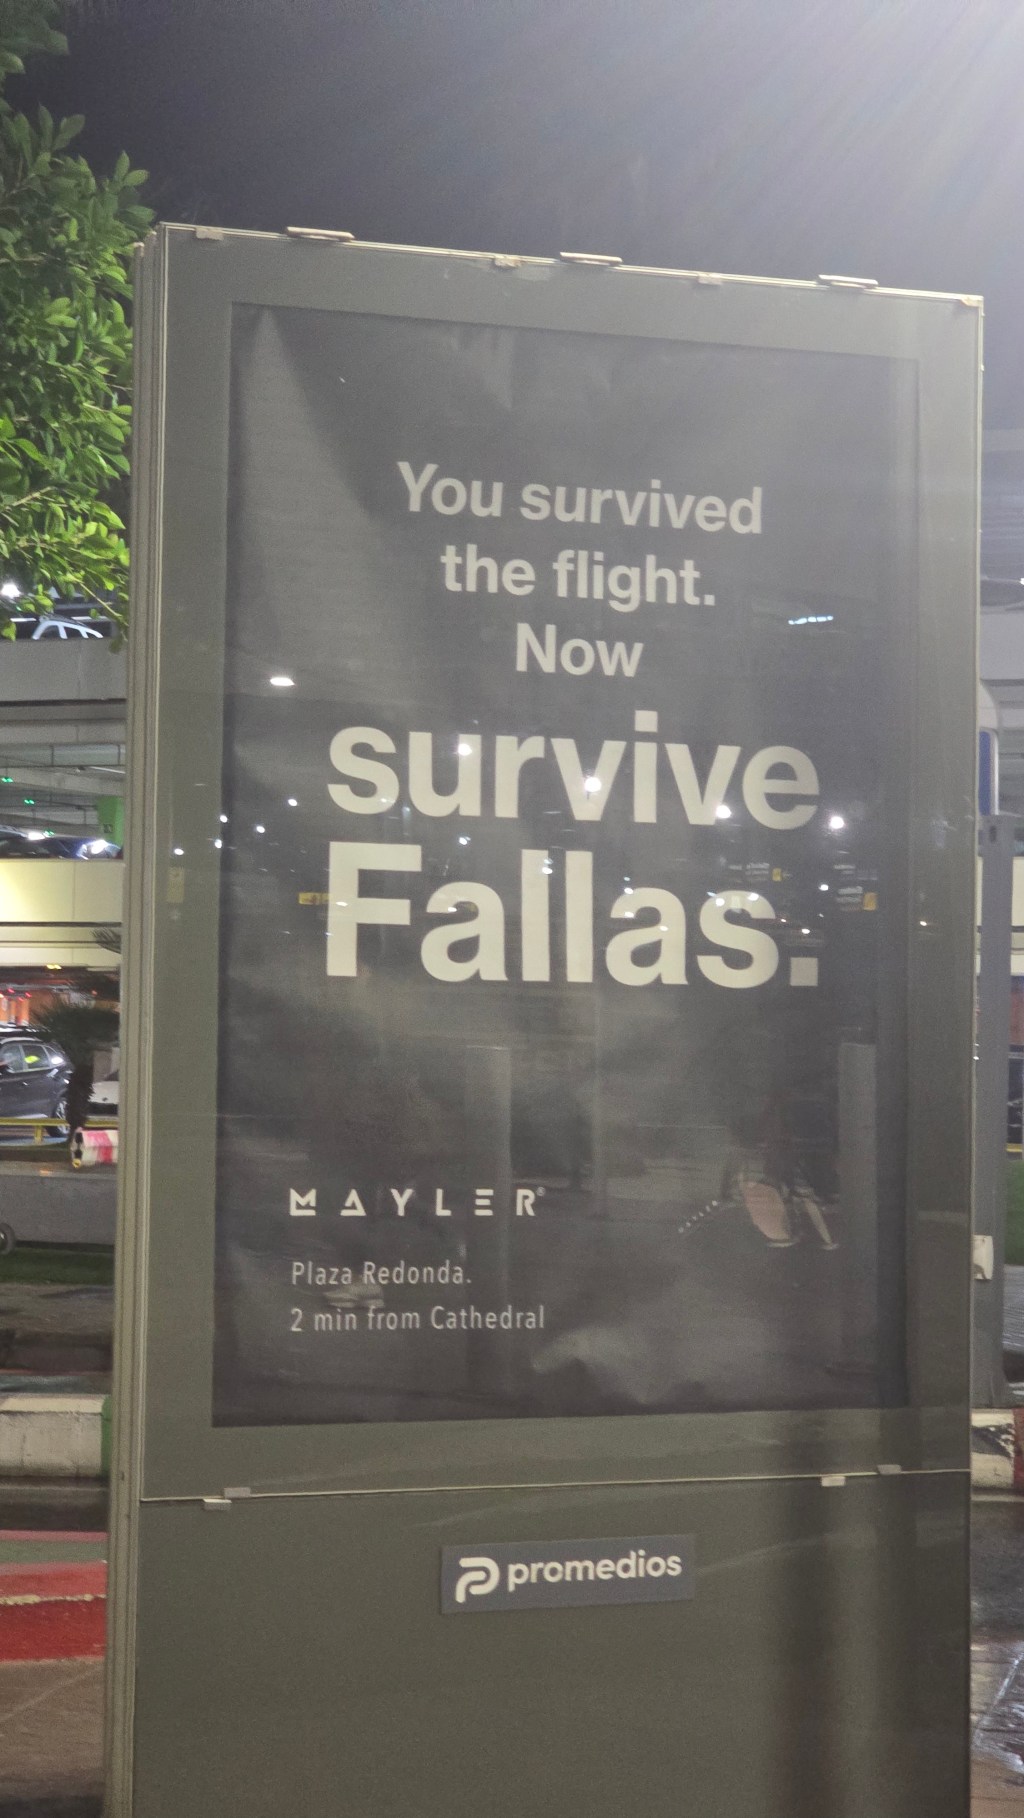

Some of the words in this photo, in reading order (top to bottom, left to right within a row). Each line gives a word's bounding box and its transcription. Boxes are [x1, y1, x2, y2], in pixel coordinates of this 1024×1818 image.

[397, 461, 503, 518] You
[520, 478, 763, 534] survived
[440, 543, 536, 596] the
[552, 549, 716, 613] flight.
[515, 622, 644, 678] Now
[327, 709, 820, 831] survive
[326, 841, 819, 989] Fallas.
[291, 1260, 352, 1285] Plaza
[362, 1259, 473, 1285] Redonda.
[289, 1307, 303, 1332] 2
[313, 1307, 358, 1331] min
[367, 1306, 421, 1330] from
[430, 1304, 545, 1330] Cathedral
[507, 1549, 682, 1592] promedios
